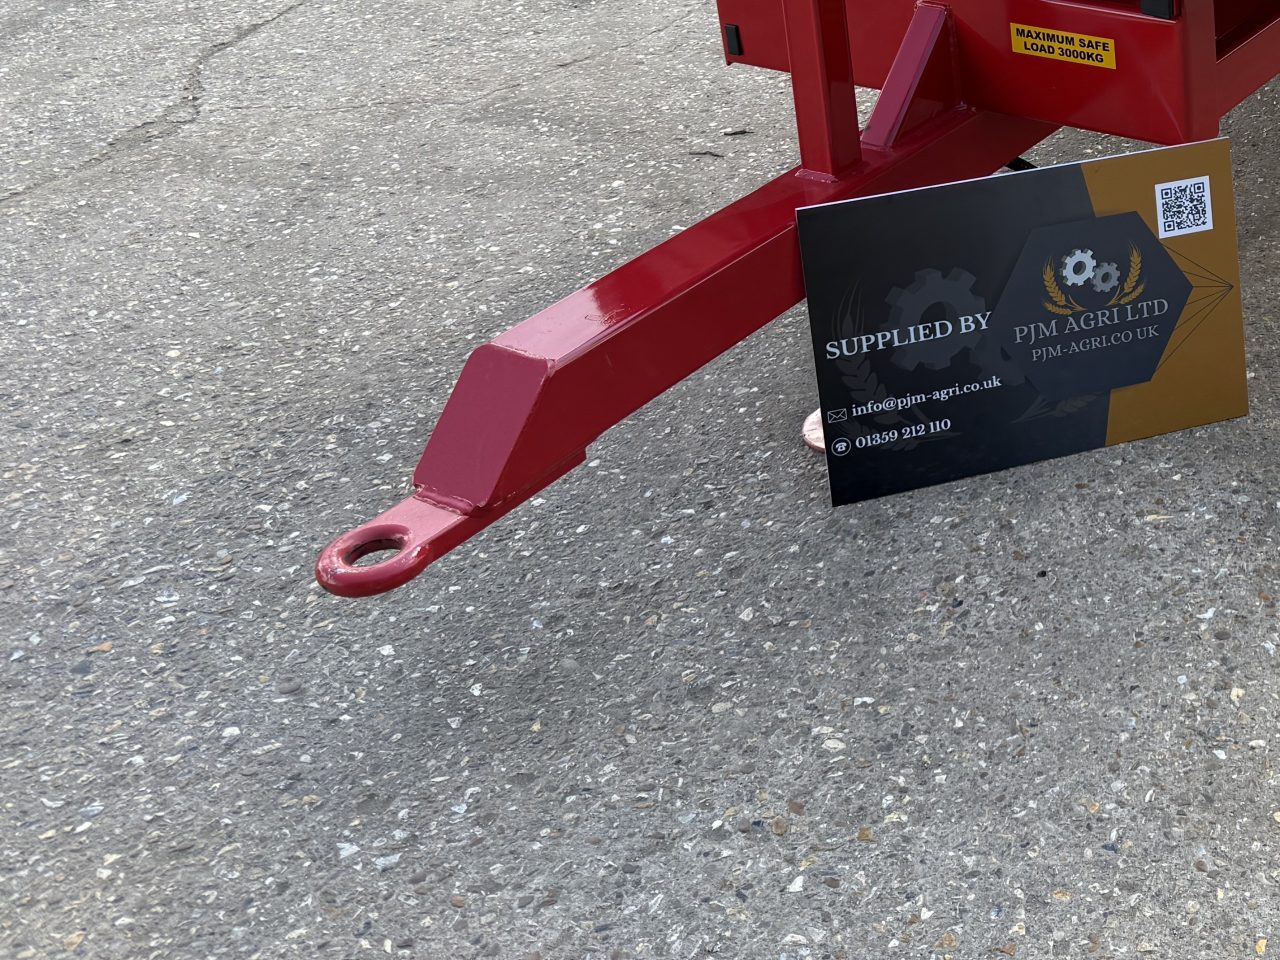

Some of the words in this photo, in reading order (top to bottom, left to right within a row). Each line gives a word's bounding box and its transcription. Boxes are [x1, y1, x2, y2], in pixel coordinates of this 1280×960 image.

[1016, 28, 1075, 46] MAXIMUM
[1079, 39, 1110, 52] SAFE
[1023, 41, 1055, 55] LOAD
[1058, 47, 1104, 63] 3000KG
[825, 320, 953, 360] SUPPLIED
[958, 311, 992, 334] BY
[1013, 319, 1059, 344] PJM
[1063, 307, 1121, 334] AGRI
[1125, 298, 1169, 321] LTD
[852, 376, 1002, 416] info@pjm-agri.co.uk
[855, 430, 898, 449] 01359
[901, 423, 926, 440] 212
[929, 418, 951, 433] 110
